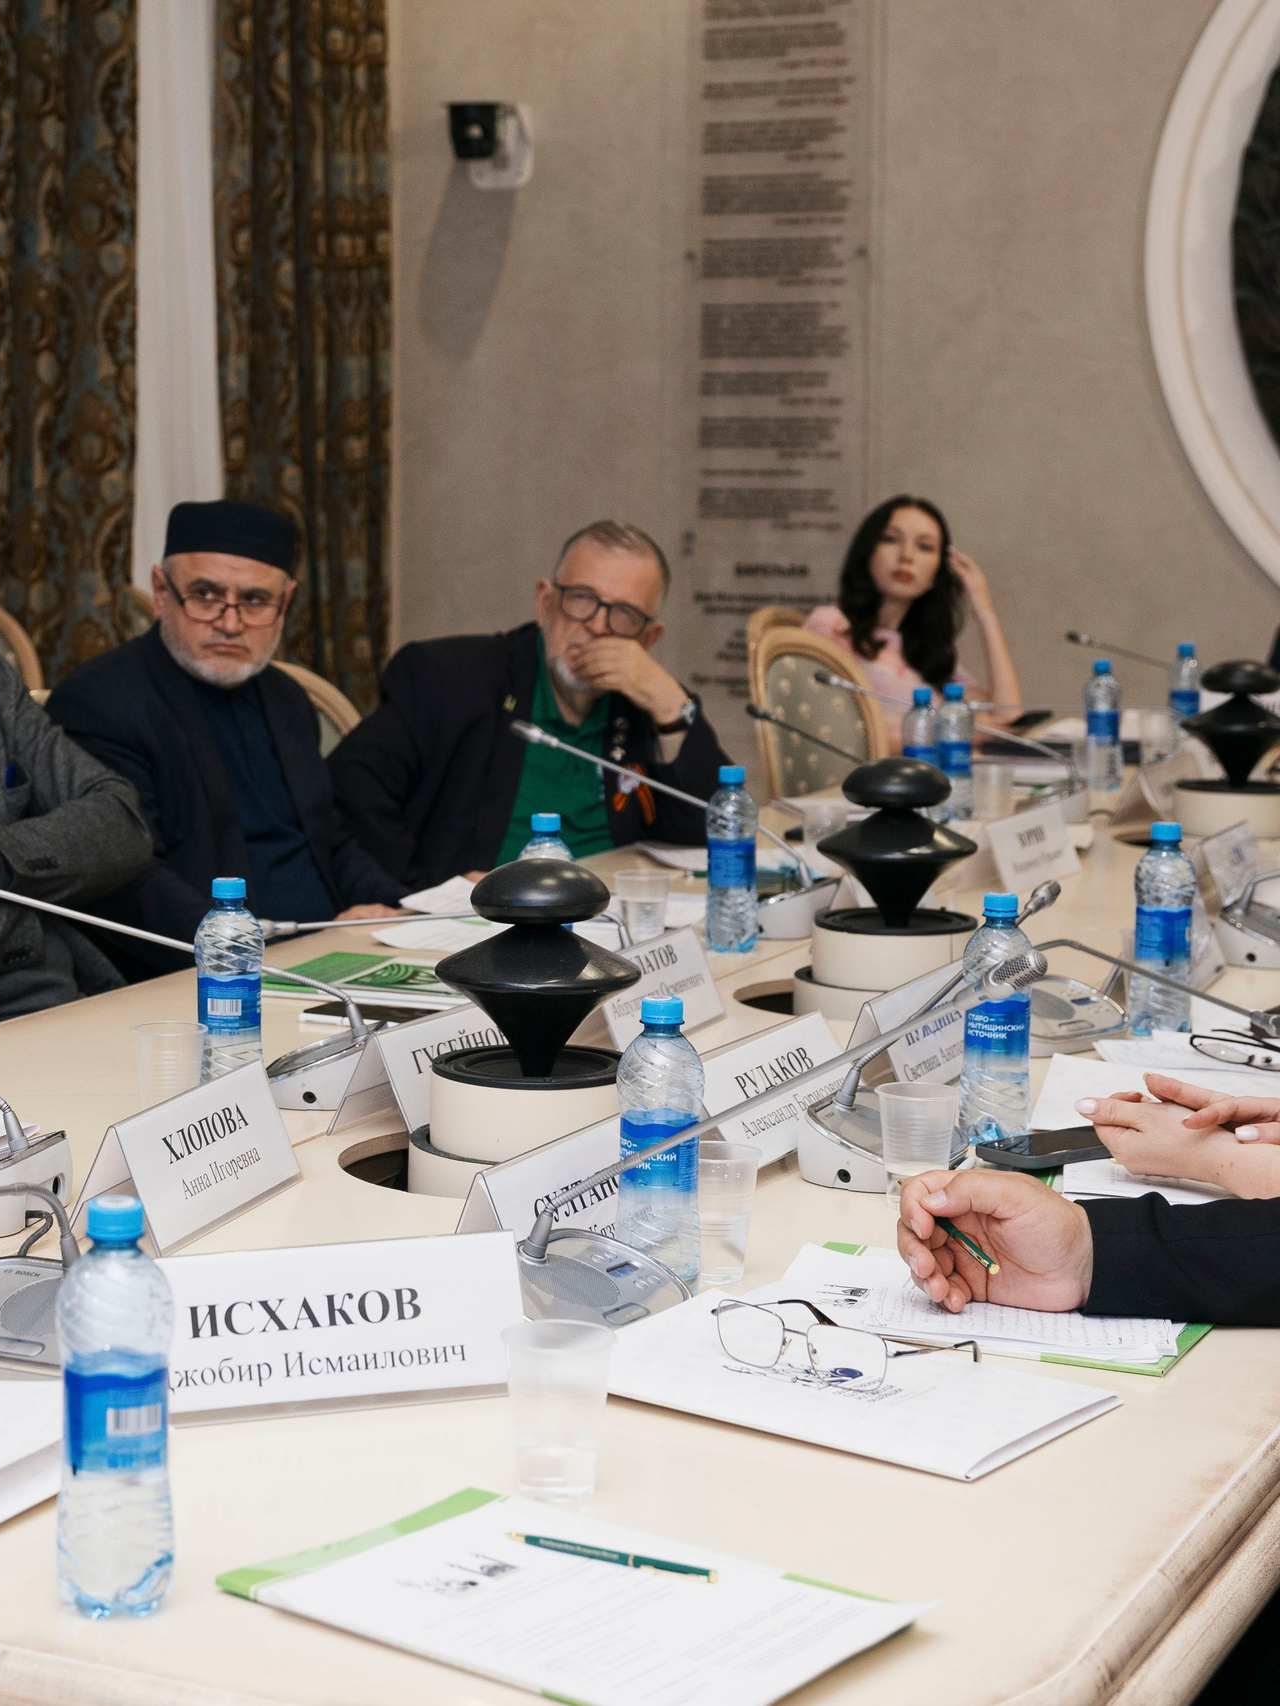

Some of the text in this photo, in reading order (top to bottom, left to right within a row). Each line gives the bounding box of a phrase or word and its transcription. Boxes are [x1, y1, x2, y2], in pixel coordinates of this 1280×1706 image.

[631, 944, 678, 976] ЛАТОВ
[734, 1047, 814, 1099] РУДАКОВ
[161, 1102, 249, 1165] ХЛОПОВА
[741, 1102, 799, 1139] Александр
[182, 1147, 261, 1200] Анна Игоревна
[534, 1173, 619, 1222] СУЛТАН
[186, 1287, 422, 1340] ИСХАКОВ
[283, 1344, 467, 1378] Исмаилович
